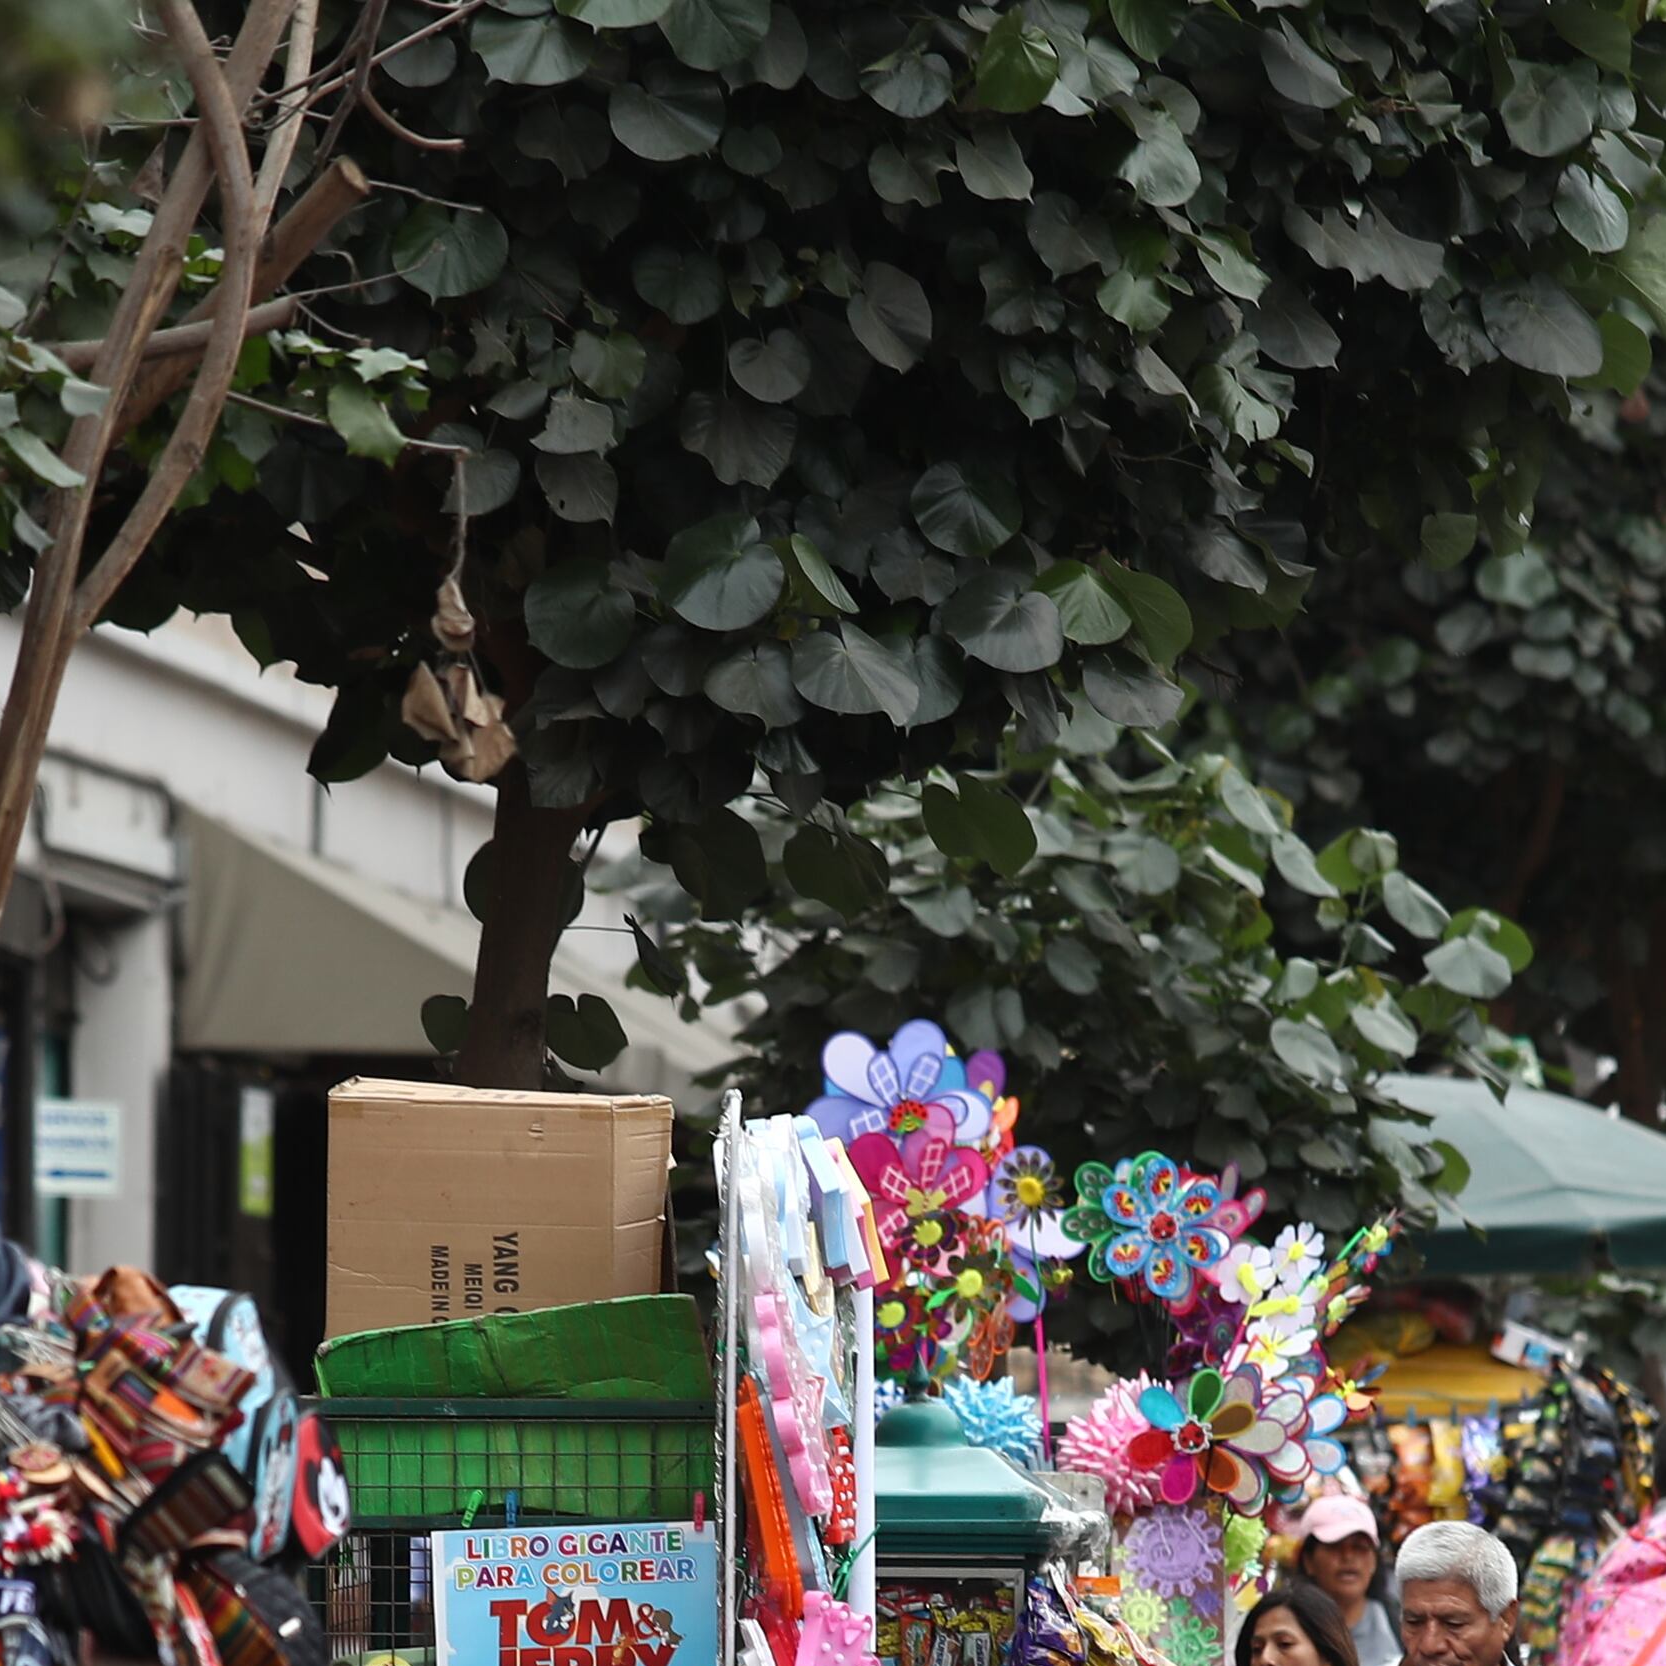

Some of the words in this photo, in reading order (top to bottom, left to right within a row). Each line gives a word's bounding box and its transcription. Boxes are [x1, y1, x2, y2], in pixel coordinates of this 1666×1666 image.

[431, 1245, 449, 1291] MADE
[493, 1232, 520, 1294] YANG
[431, 1294, 450, 1312] IN
[464, 1264, 483, 1310] MEIQI
[466, 1534, 550, 1560] LIBRO
[558, 1529, 684, 1556] GIGANTE
[456, 1564, 534, 1589] PARA
[542, 1558, 697, 1586] COLOREAR
[489, 1597, 637, 1649] TOM
